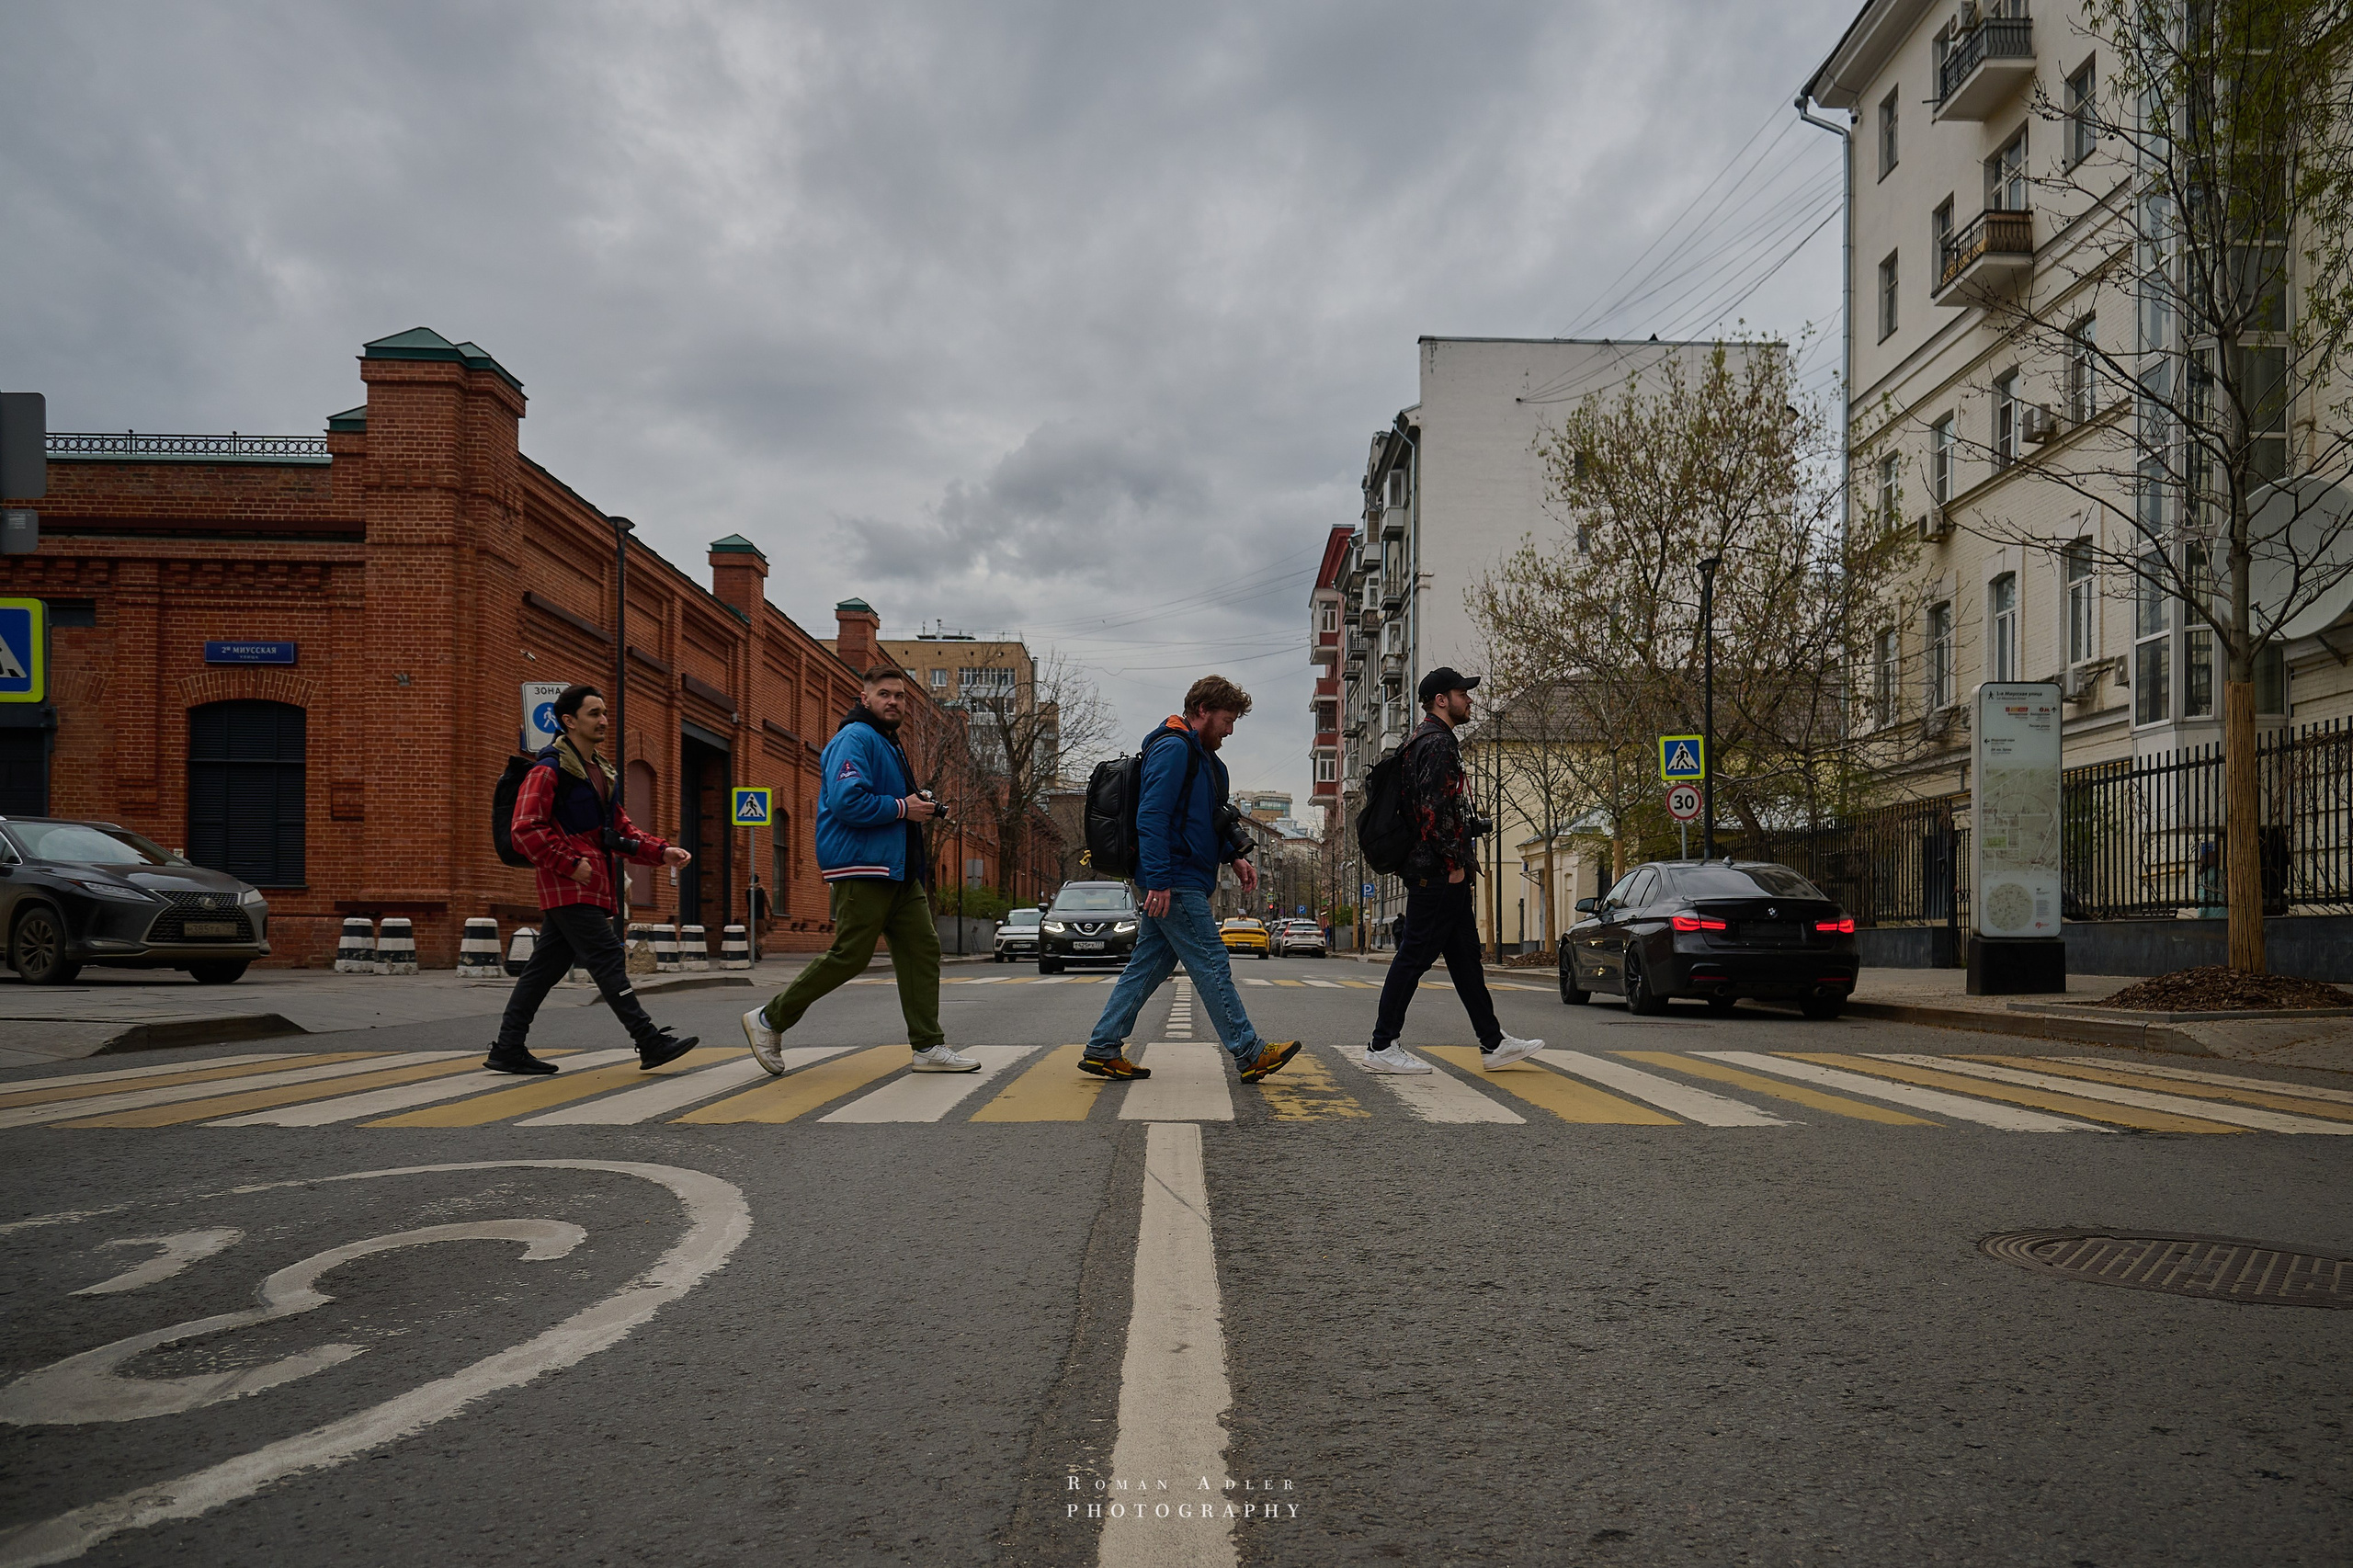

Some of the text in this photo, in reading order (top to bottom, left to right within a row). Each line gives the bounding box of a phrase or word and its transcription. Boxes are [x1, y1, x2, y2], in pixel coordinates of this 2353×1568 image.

[233, 646, 277, 654] МИУССКАЯ
[534, 687, 561, 695] ЗОНА
[1674, 795, 1695, 810] 30
